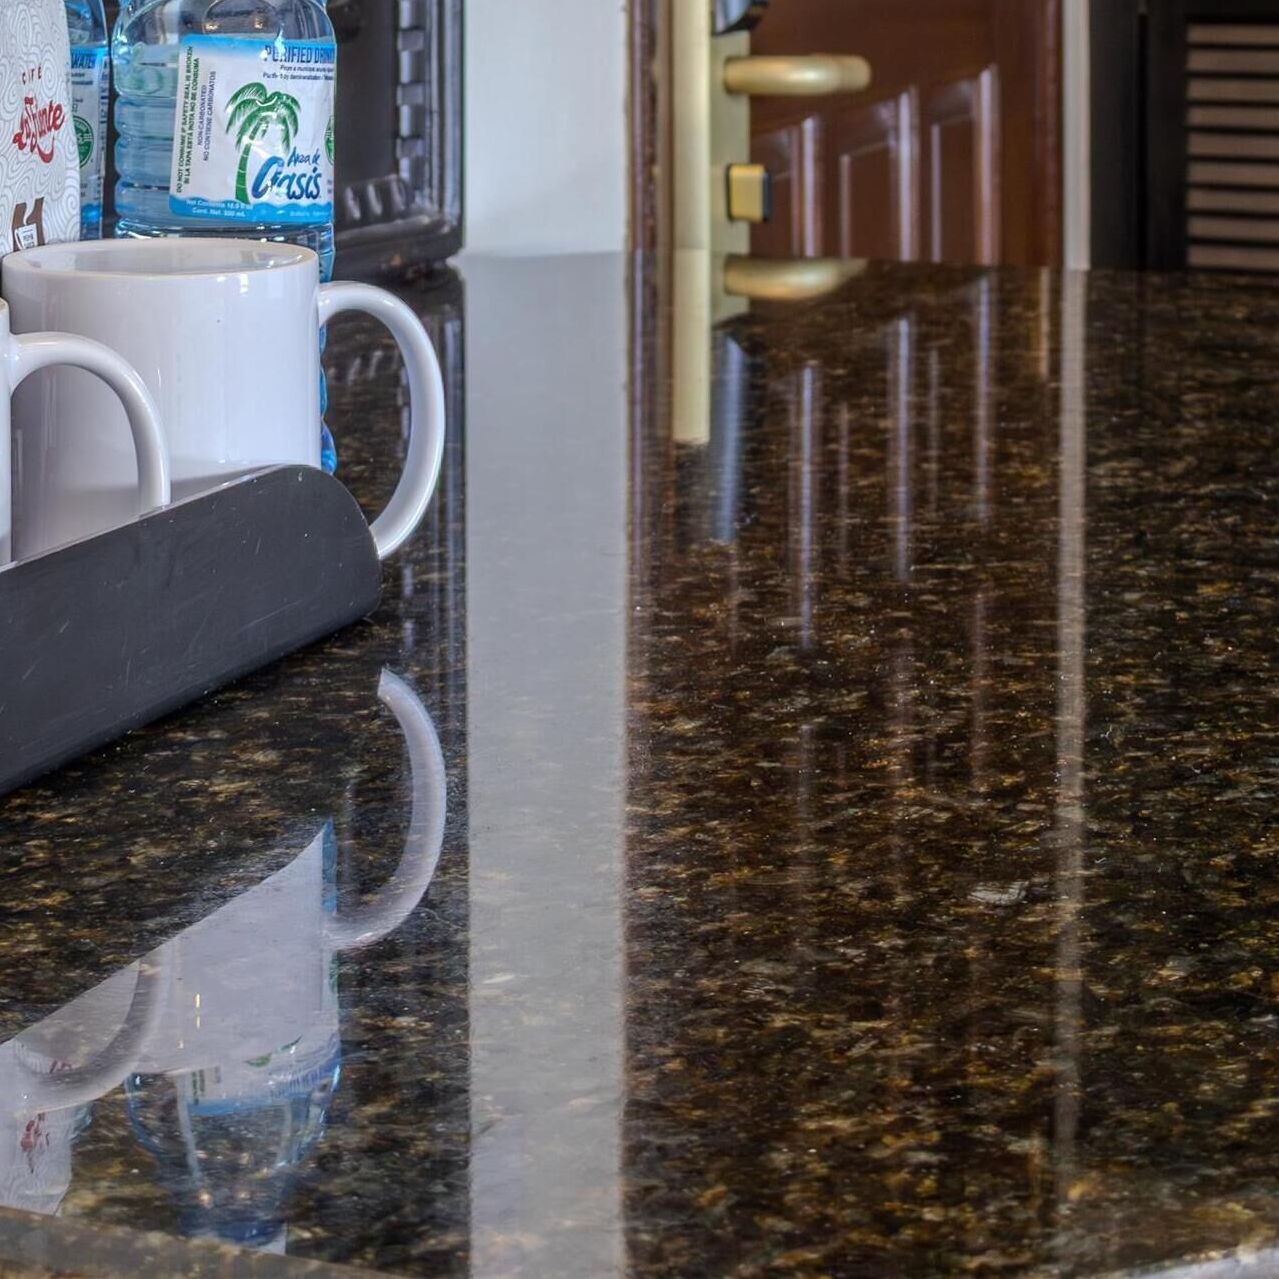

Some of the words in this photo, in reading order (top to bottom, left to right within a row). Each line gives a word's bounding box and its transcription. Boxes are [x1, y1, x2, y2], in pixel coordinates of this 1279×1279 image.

[263, 45, 312, 63] PURIFIED
[207, 71, 217, 116] CARBONATOS
[189, 101, 196, 112] NO
[204, 117, 212, 150] CONTIENE
[203, 150, 210, 161] NO
